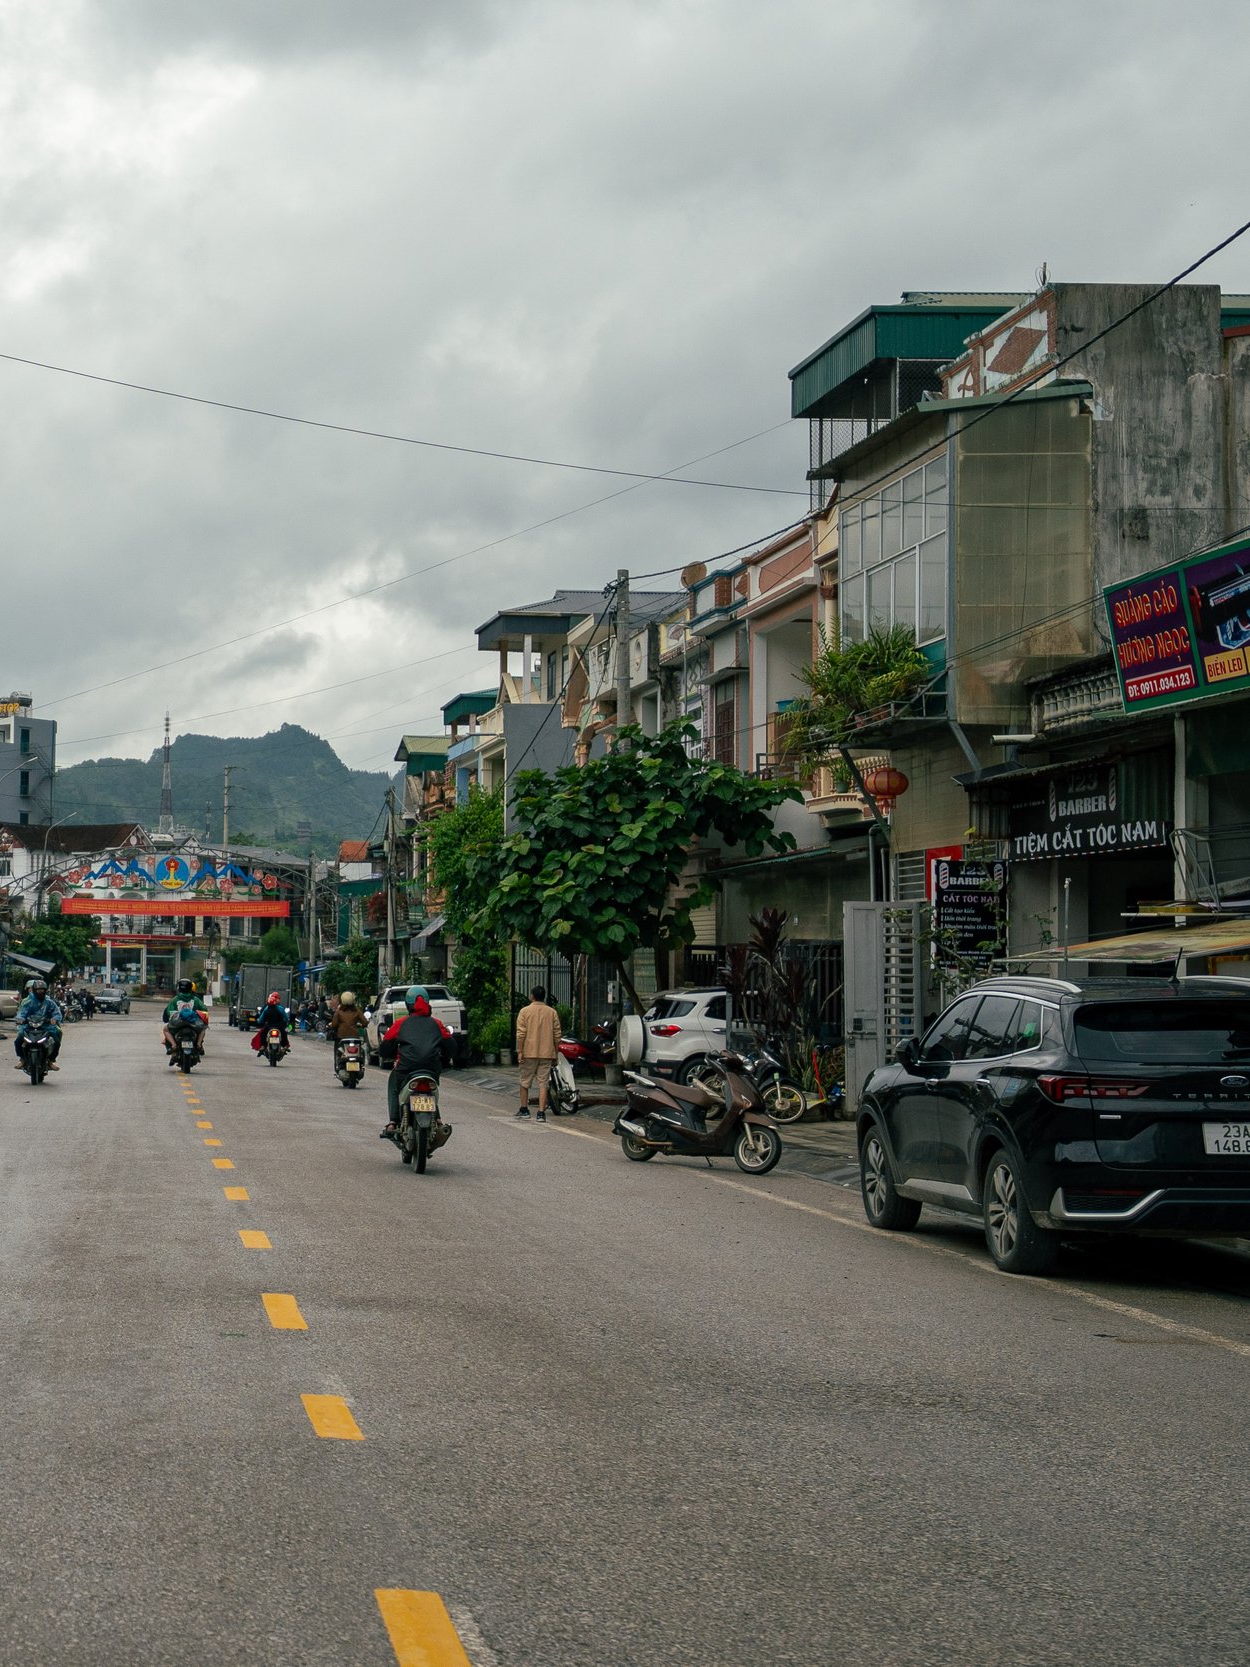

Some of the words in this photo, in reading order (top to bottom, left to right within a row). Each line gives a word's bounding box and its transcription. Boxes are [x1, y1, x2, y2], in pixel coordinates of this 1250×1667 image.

[1114, 588, 1152, 628] QUẢNG
[1153, 579, 1179, 617] CÁO
[1116, 635, 1156, 670] HƯƠNG
[1155, 626, 1191, 663] NGỌC
[1207, 656, 1227, 678] BIỂN
[1228, 657, 1243, 673] LED
[1128, 686, 1140, 698] ĐT:
[1140, 672, 1191, 696] 0911.034.123
[1067, 770, 1099, 794] 123
[1058, 795, 1107, 817] BARBER
[1014, 832, 1049, 856] TIỆM
[1052, 823, 1083, 850] CẮT
[1087, 823, 1117, 847] TÓC
[1121, 820, 1158, 844] NAM
[950, 876, 992, 886] BARBE
[962, 893, 979, 903] TÓC
[1223, 1125, 1250, 1138] 23A
